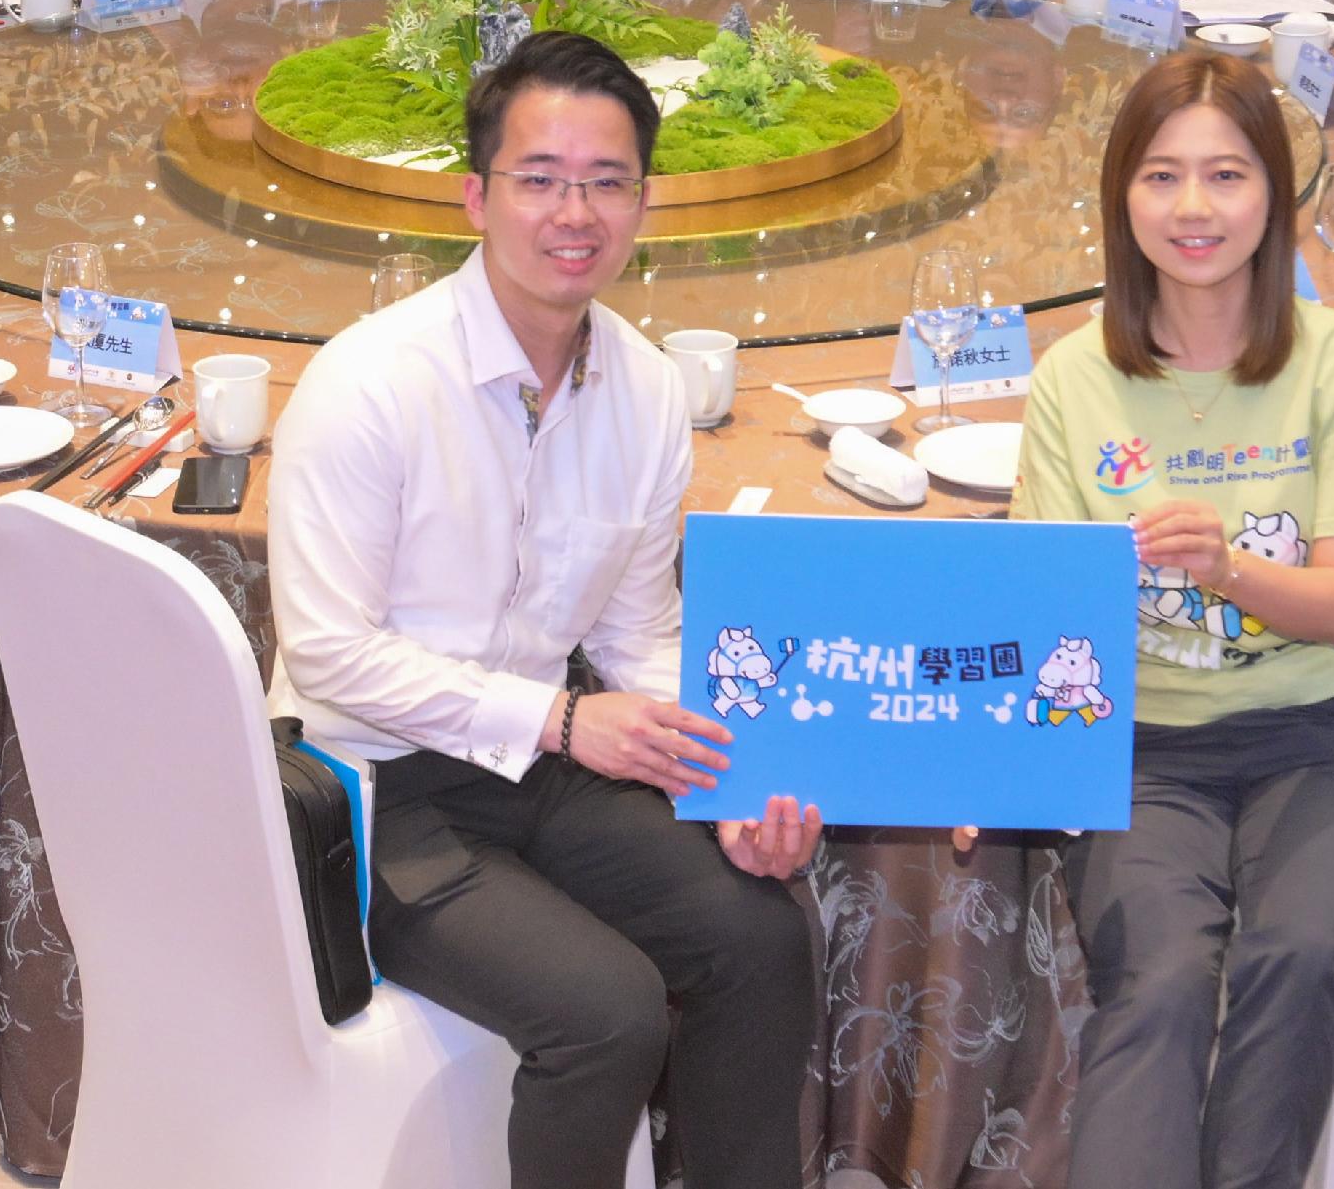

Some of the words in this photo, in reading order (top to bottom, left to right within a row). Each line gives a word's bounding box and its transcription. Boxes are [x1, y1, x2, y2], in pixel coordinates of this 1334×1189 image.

[1169, 474, 1200, 485] Strive
[1203, 473, 1224, 485] and
[1226, 471, 1248, 482] Rise
[806, 636, 1024, 690] 杭州學習團
[869, 692, 960, 723] 2024
